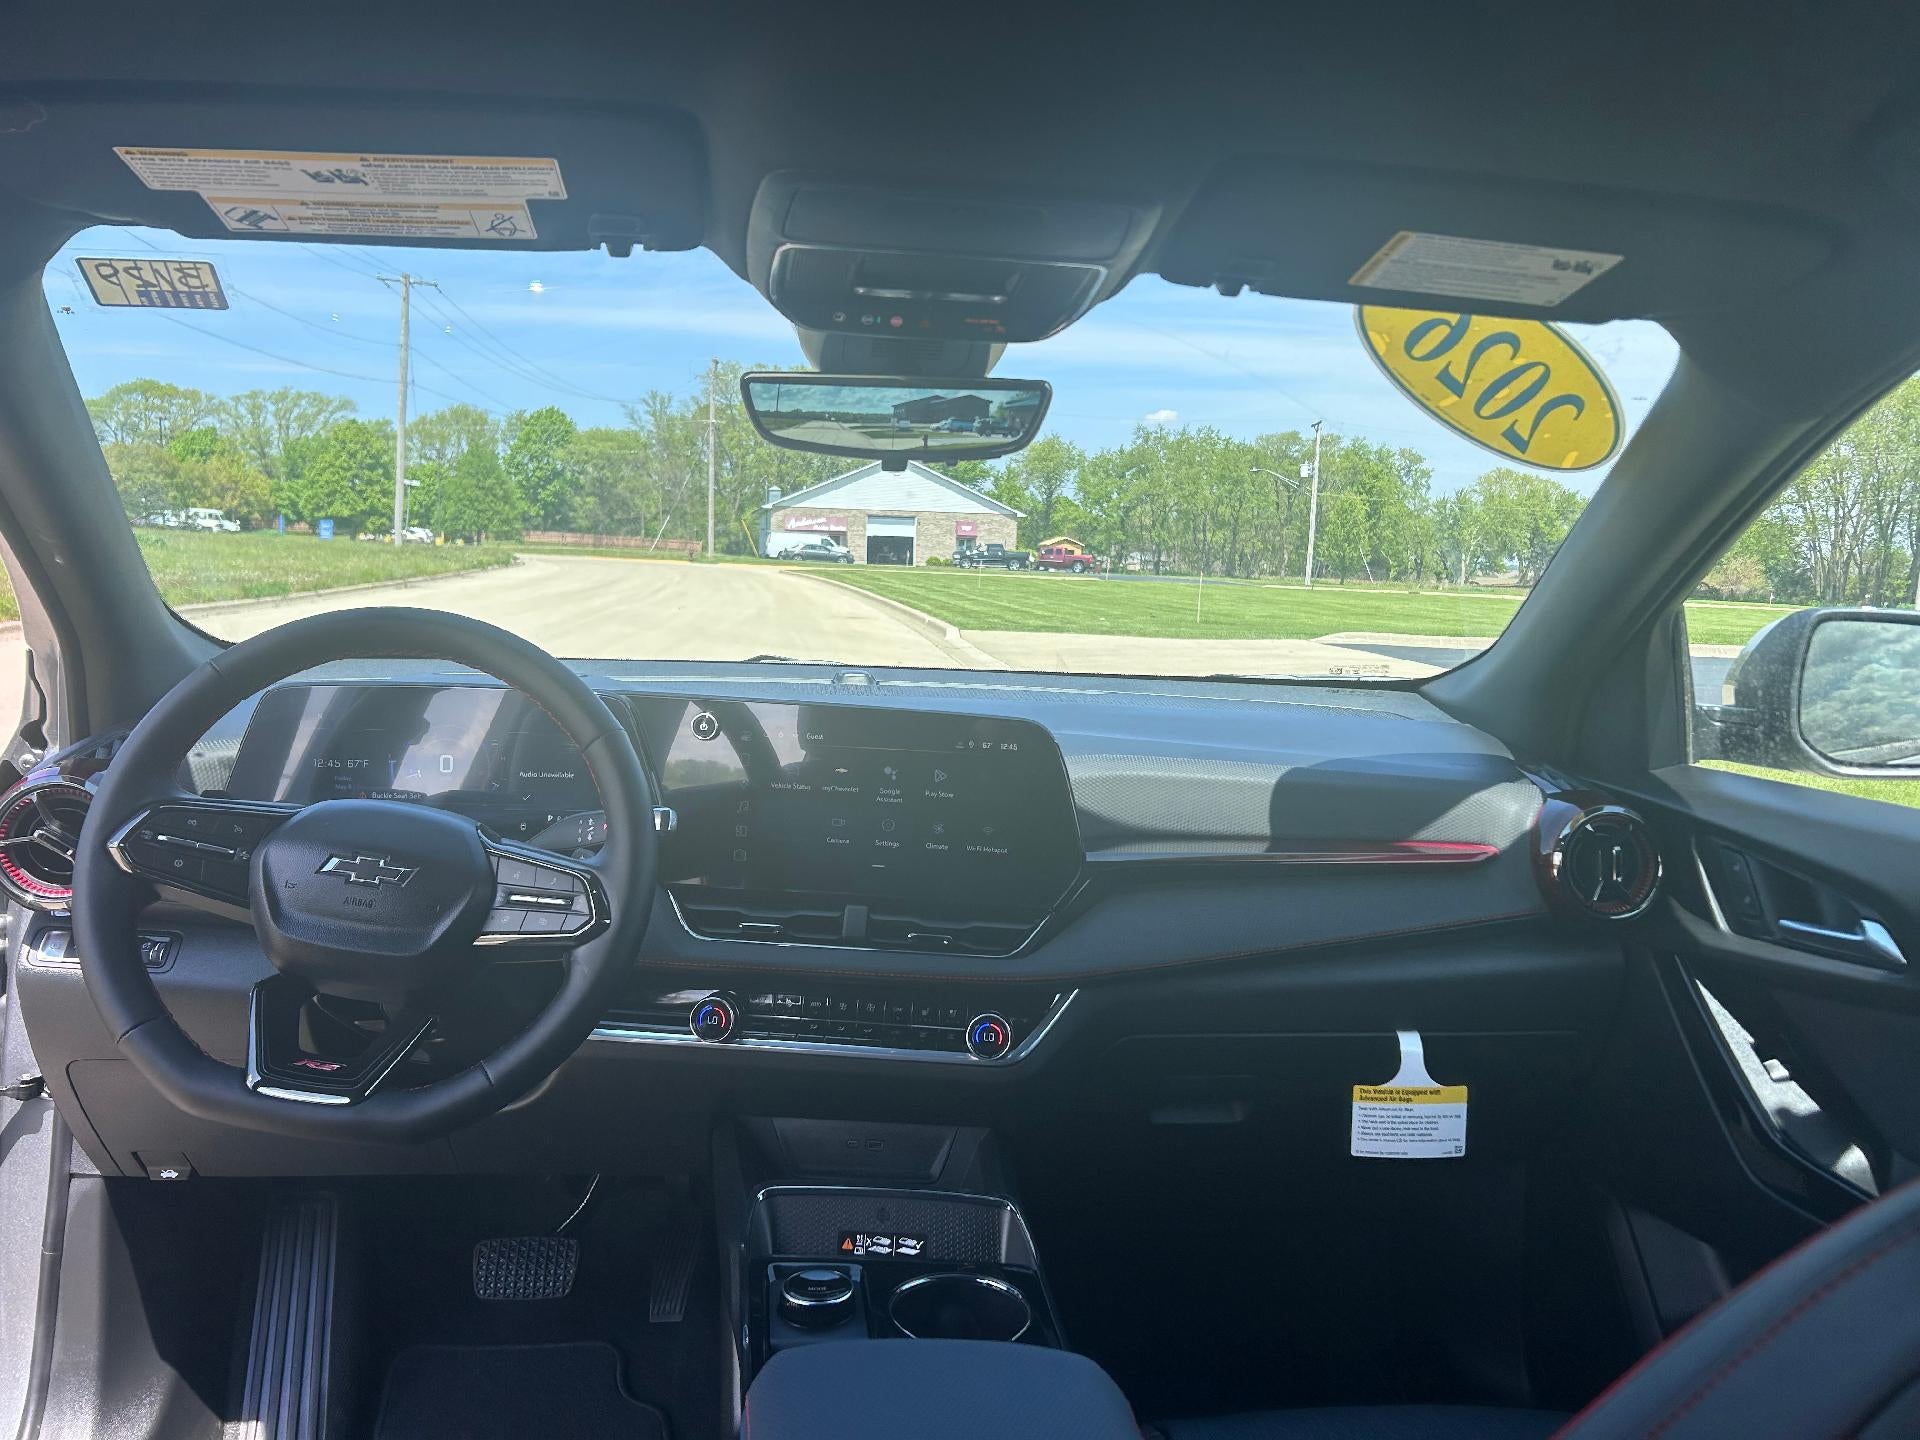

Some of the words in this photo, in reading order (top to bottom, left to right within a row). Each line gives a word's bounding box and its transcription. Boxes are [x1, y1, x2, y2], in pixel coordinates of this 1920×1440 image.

[313, 758, 341, 768] 12:45
[874, 839, 901, 848] Settings
[925, 842, 949, 850] Climate
